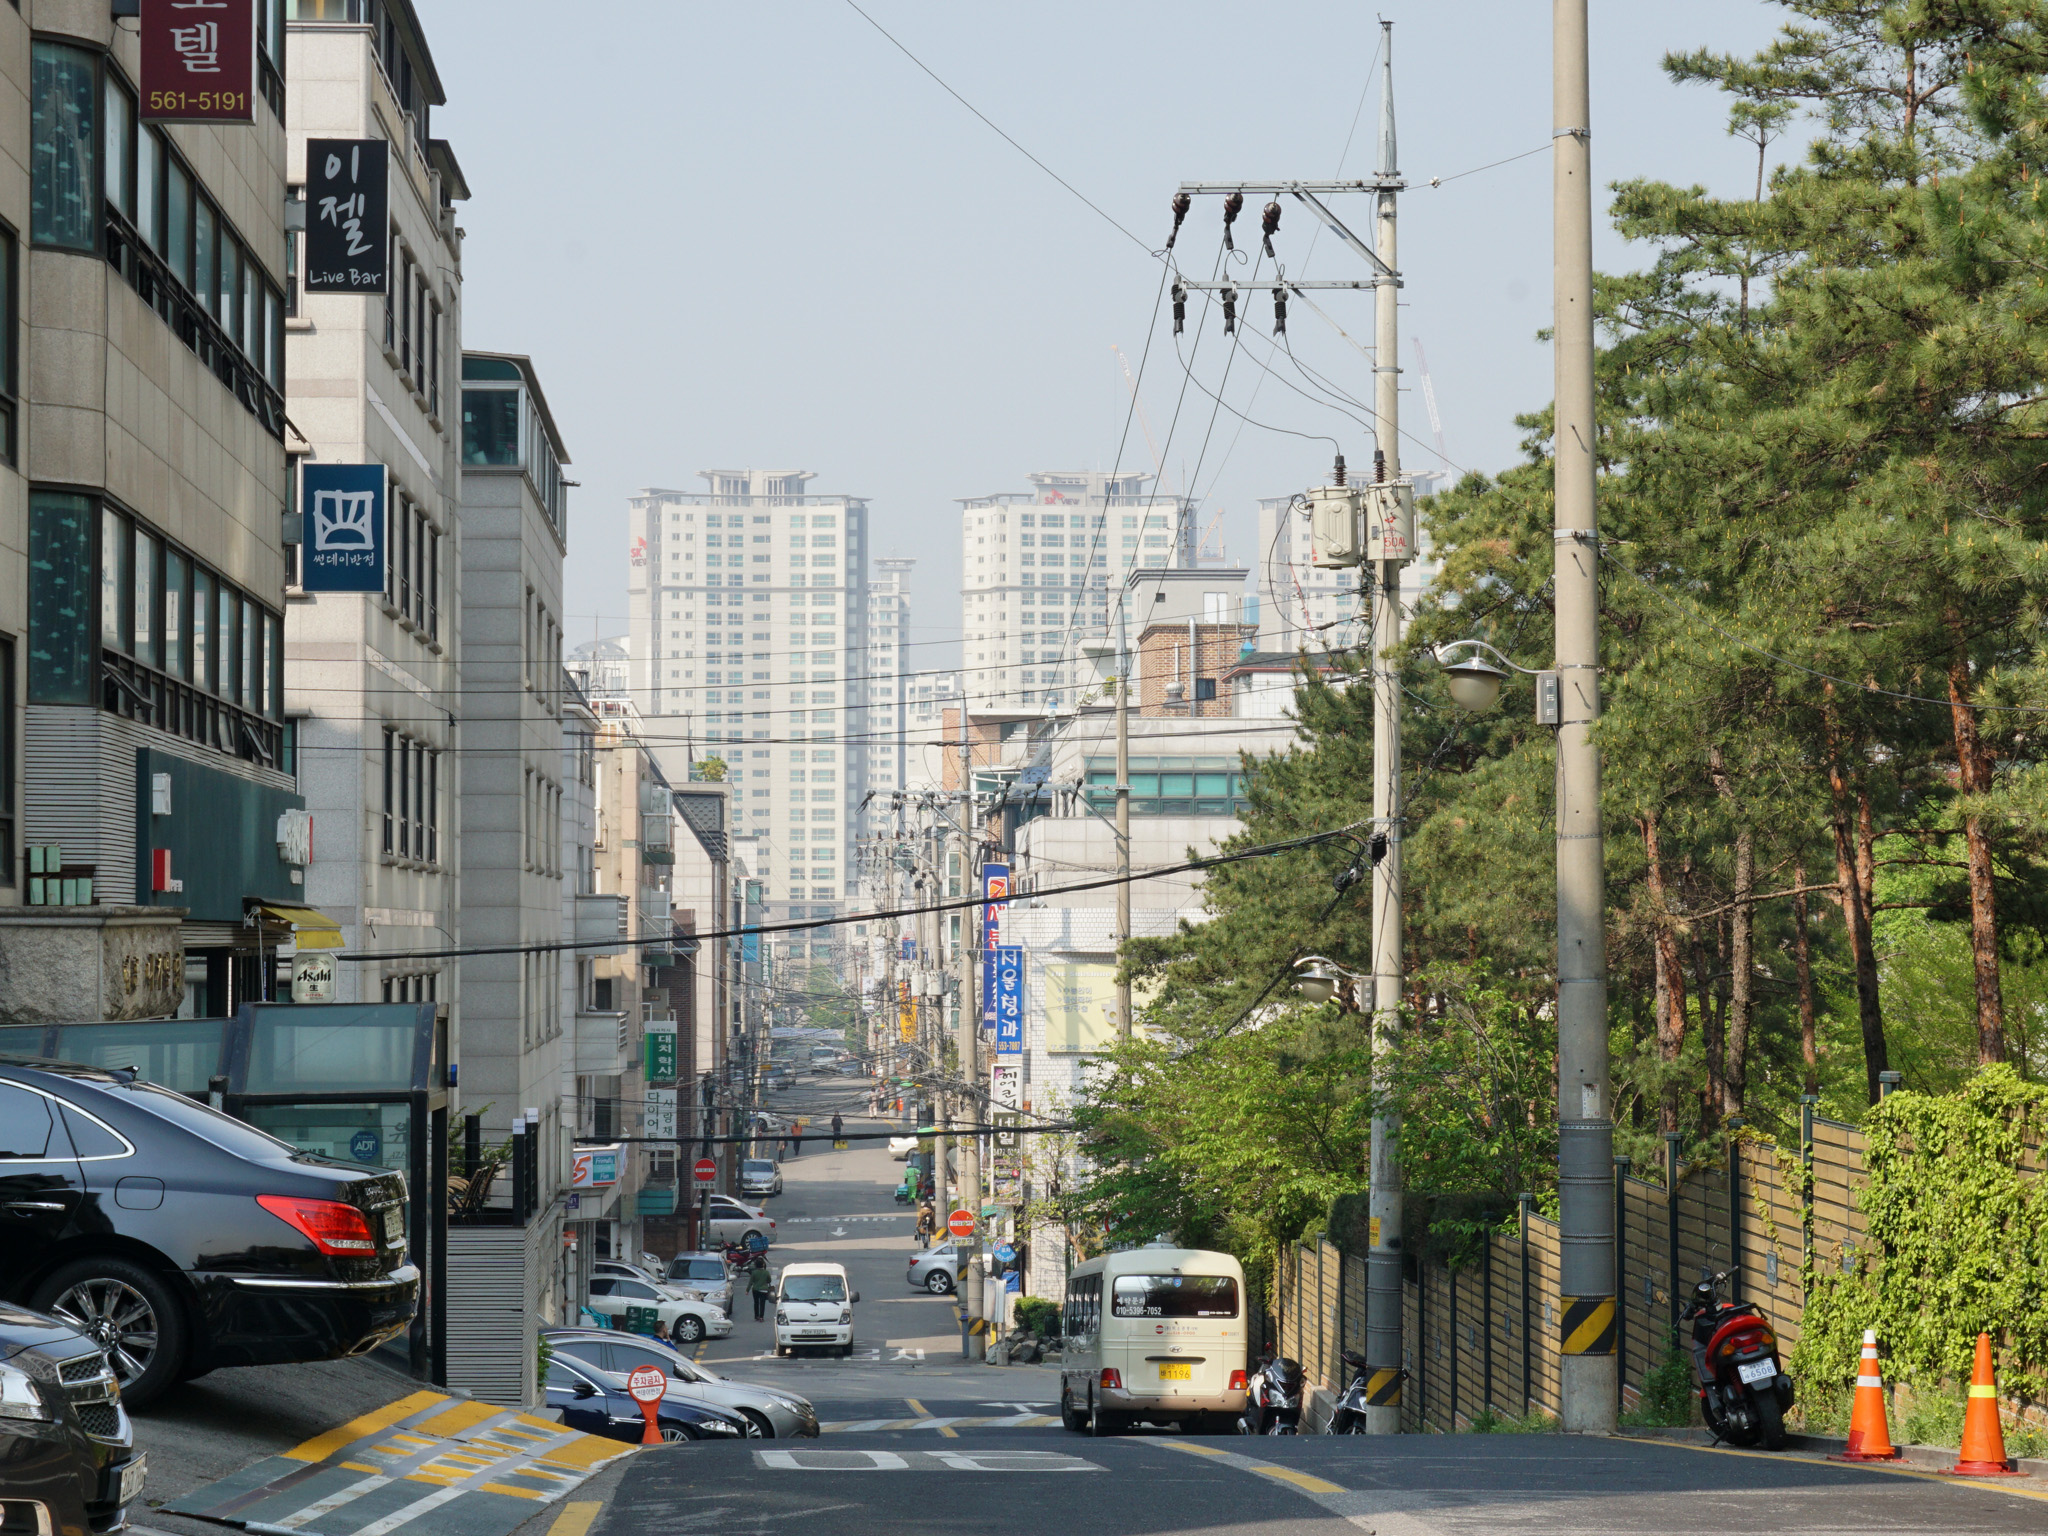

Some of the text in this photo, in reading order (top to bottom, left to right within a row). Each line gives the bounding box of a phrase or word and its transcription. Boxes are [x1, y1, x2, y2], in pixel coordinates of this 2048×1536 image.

[150, 91, 244, 111] 561-5191
[318, 145, 373, 256] 이젤
[309, 268, 382, 286] Live Bar
[313, 552, 374, 567] 썬데이반점
[297, 968, 332, 982] Asahi
[658, 1034, 673, 1075] 대치학사
[354, 1140, 376, 1151] ADT
[1167, 1370, 1190, 1379] 1196
[1750, 1365, 1773, 1378] 6508
[633, 1374, 661, 1386] 주차금지
